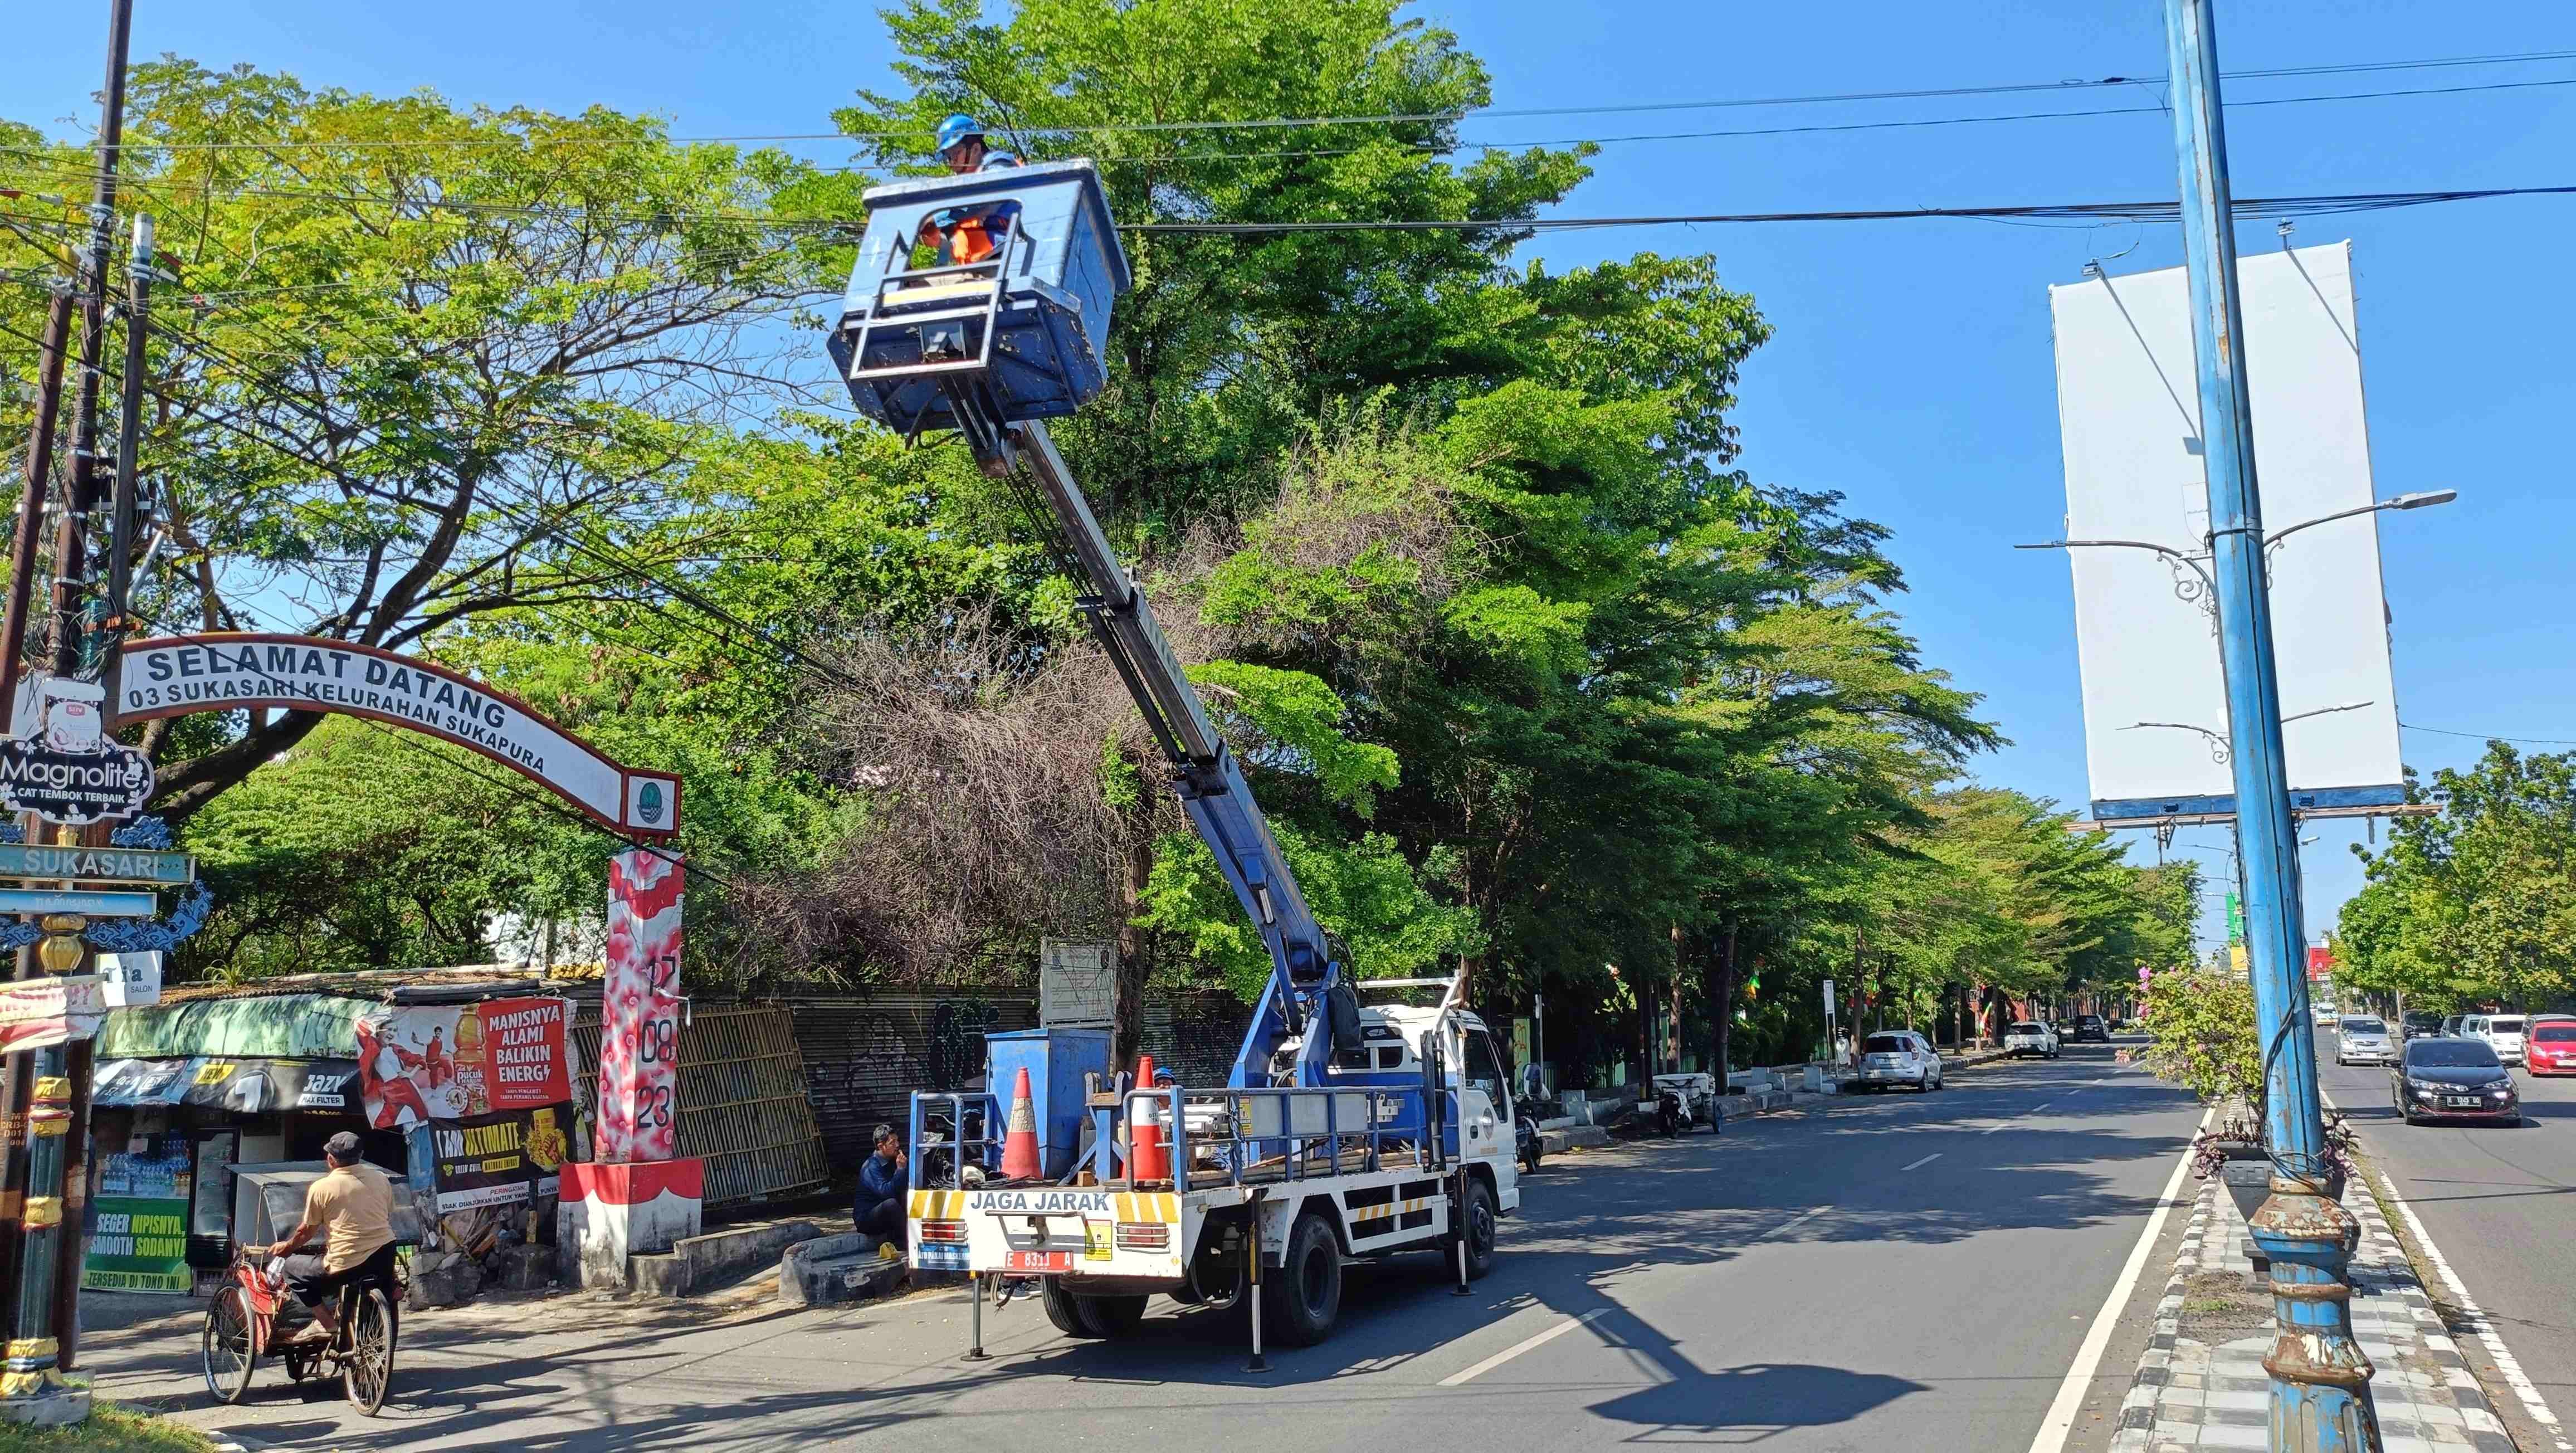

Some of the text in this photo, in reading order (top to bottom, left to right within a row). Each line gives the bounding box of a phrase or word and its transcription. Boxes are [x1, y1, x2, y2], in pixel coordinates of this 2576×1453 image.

[148, 645, 506, 728] SELAMAT DATANG
[129, 679, 545, 773] 03 SUKASARI KELURAHAN SUKAPURA
[1, 755, 140, 789] Magnolite
[18, 788, 125, 803] CAT TEMBOK TERBAIK
[25, 850, 158, 876] SUKASARI
[648, 955, 676, 996] 17
[489, 1005, 560, 1032] MANISNYA
[502, 1026, 544, 1046] ALAMI
[642, 1020, 672, 1063] 08
[496, 1045, 551, 1064] BALIKIN
[637, 1085, 670, 1128] 23
[464, 1122, 521, 1157] ULTIMATE
[971, 1192, 1110, 1211] JAGA JARAK
[97, 1213, 185, 1237] SEGER NIPISNYA,
[91, 1235, 134, 1255] SMOOTH
[1007, 1253, 1013, 1266] E
[1064, 1253, 1071, 1266] A
[89, 1272, 180, 1289] TERSEDIA DI TOKO INI
